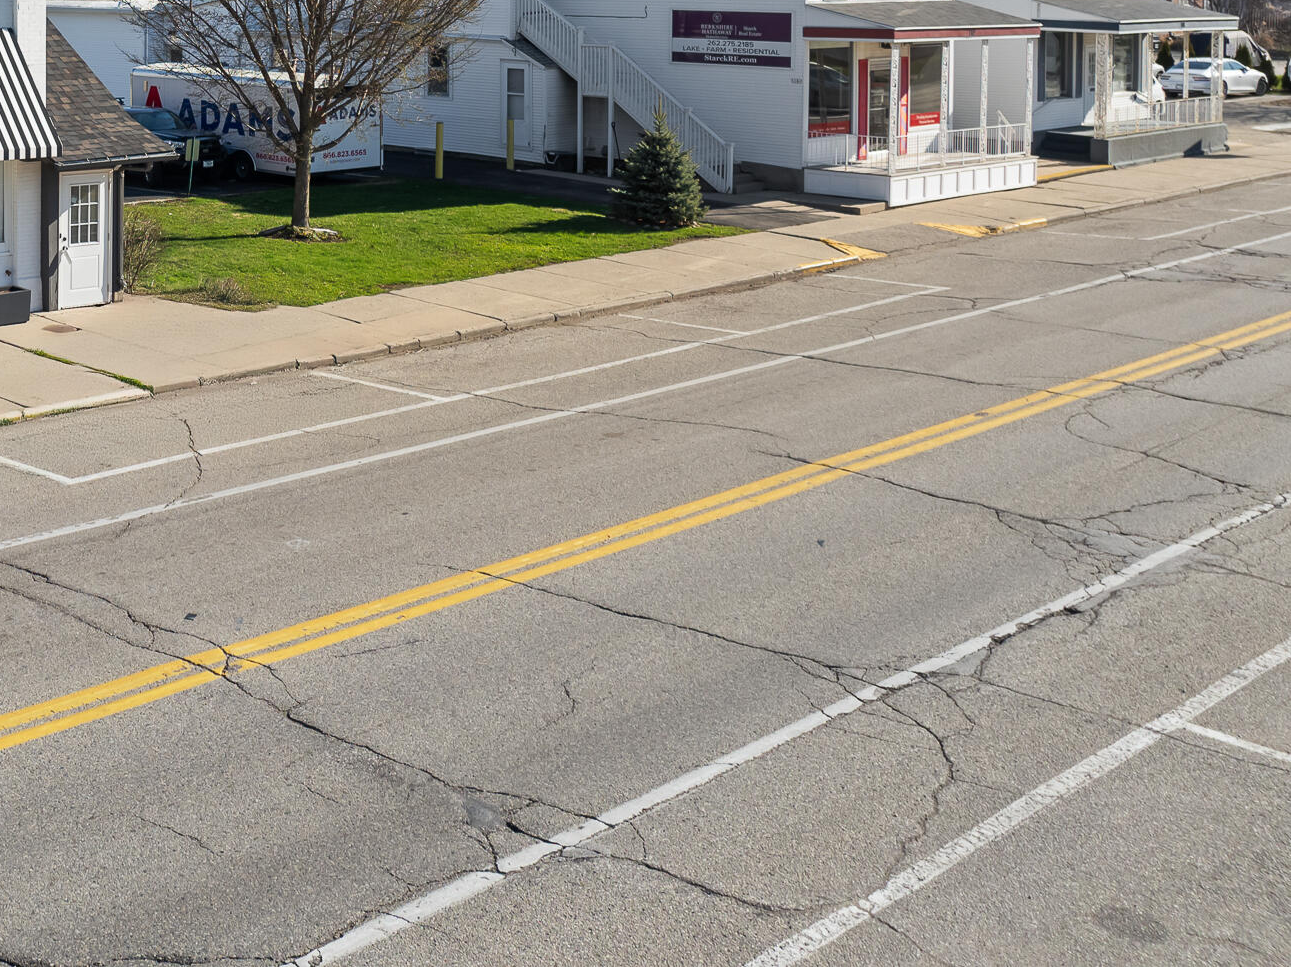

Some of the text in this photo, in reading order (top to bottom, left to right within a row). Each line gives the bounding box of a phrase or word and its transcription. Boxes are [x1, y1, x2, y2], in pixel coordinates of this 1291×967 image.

[707, 39, 755, 48] 262.275.2185
[733, 47, 780, 56] RESIDENTIAL
[704, 54, 757, 63] StarckRE.com
[179, 98, 296, 142] ADAMS
